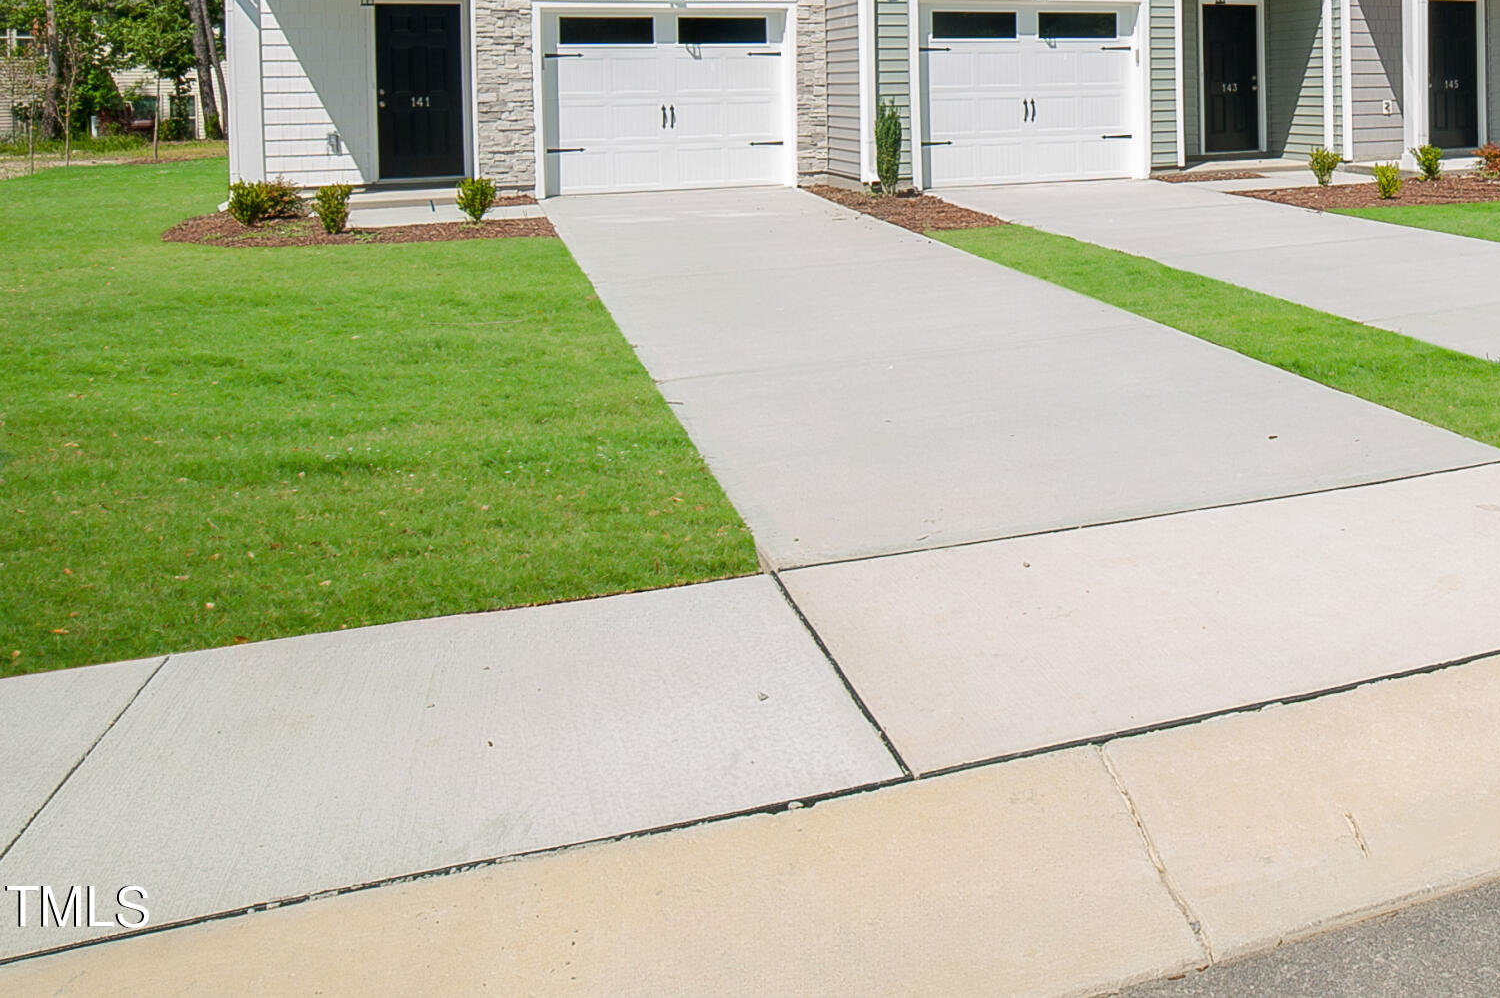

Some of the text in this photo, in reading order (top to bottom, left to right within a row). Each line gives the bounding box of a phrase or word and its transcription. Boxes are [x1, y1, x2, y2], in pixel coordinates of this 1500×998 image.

[1222, 83, 1238, 92] 143
[1444, 79, 1459, 89] 145
[410, 96, 431, 107] 141
